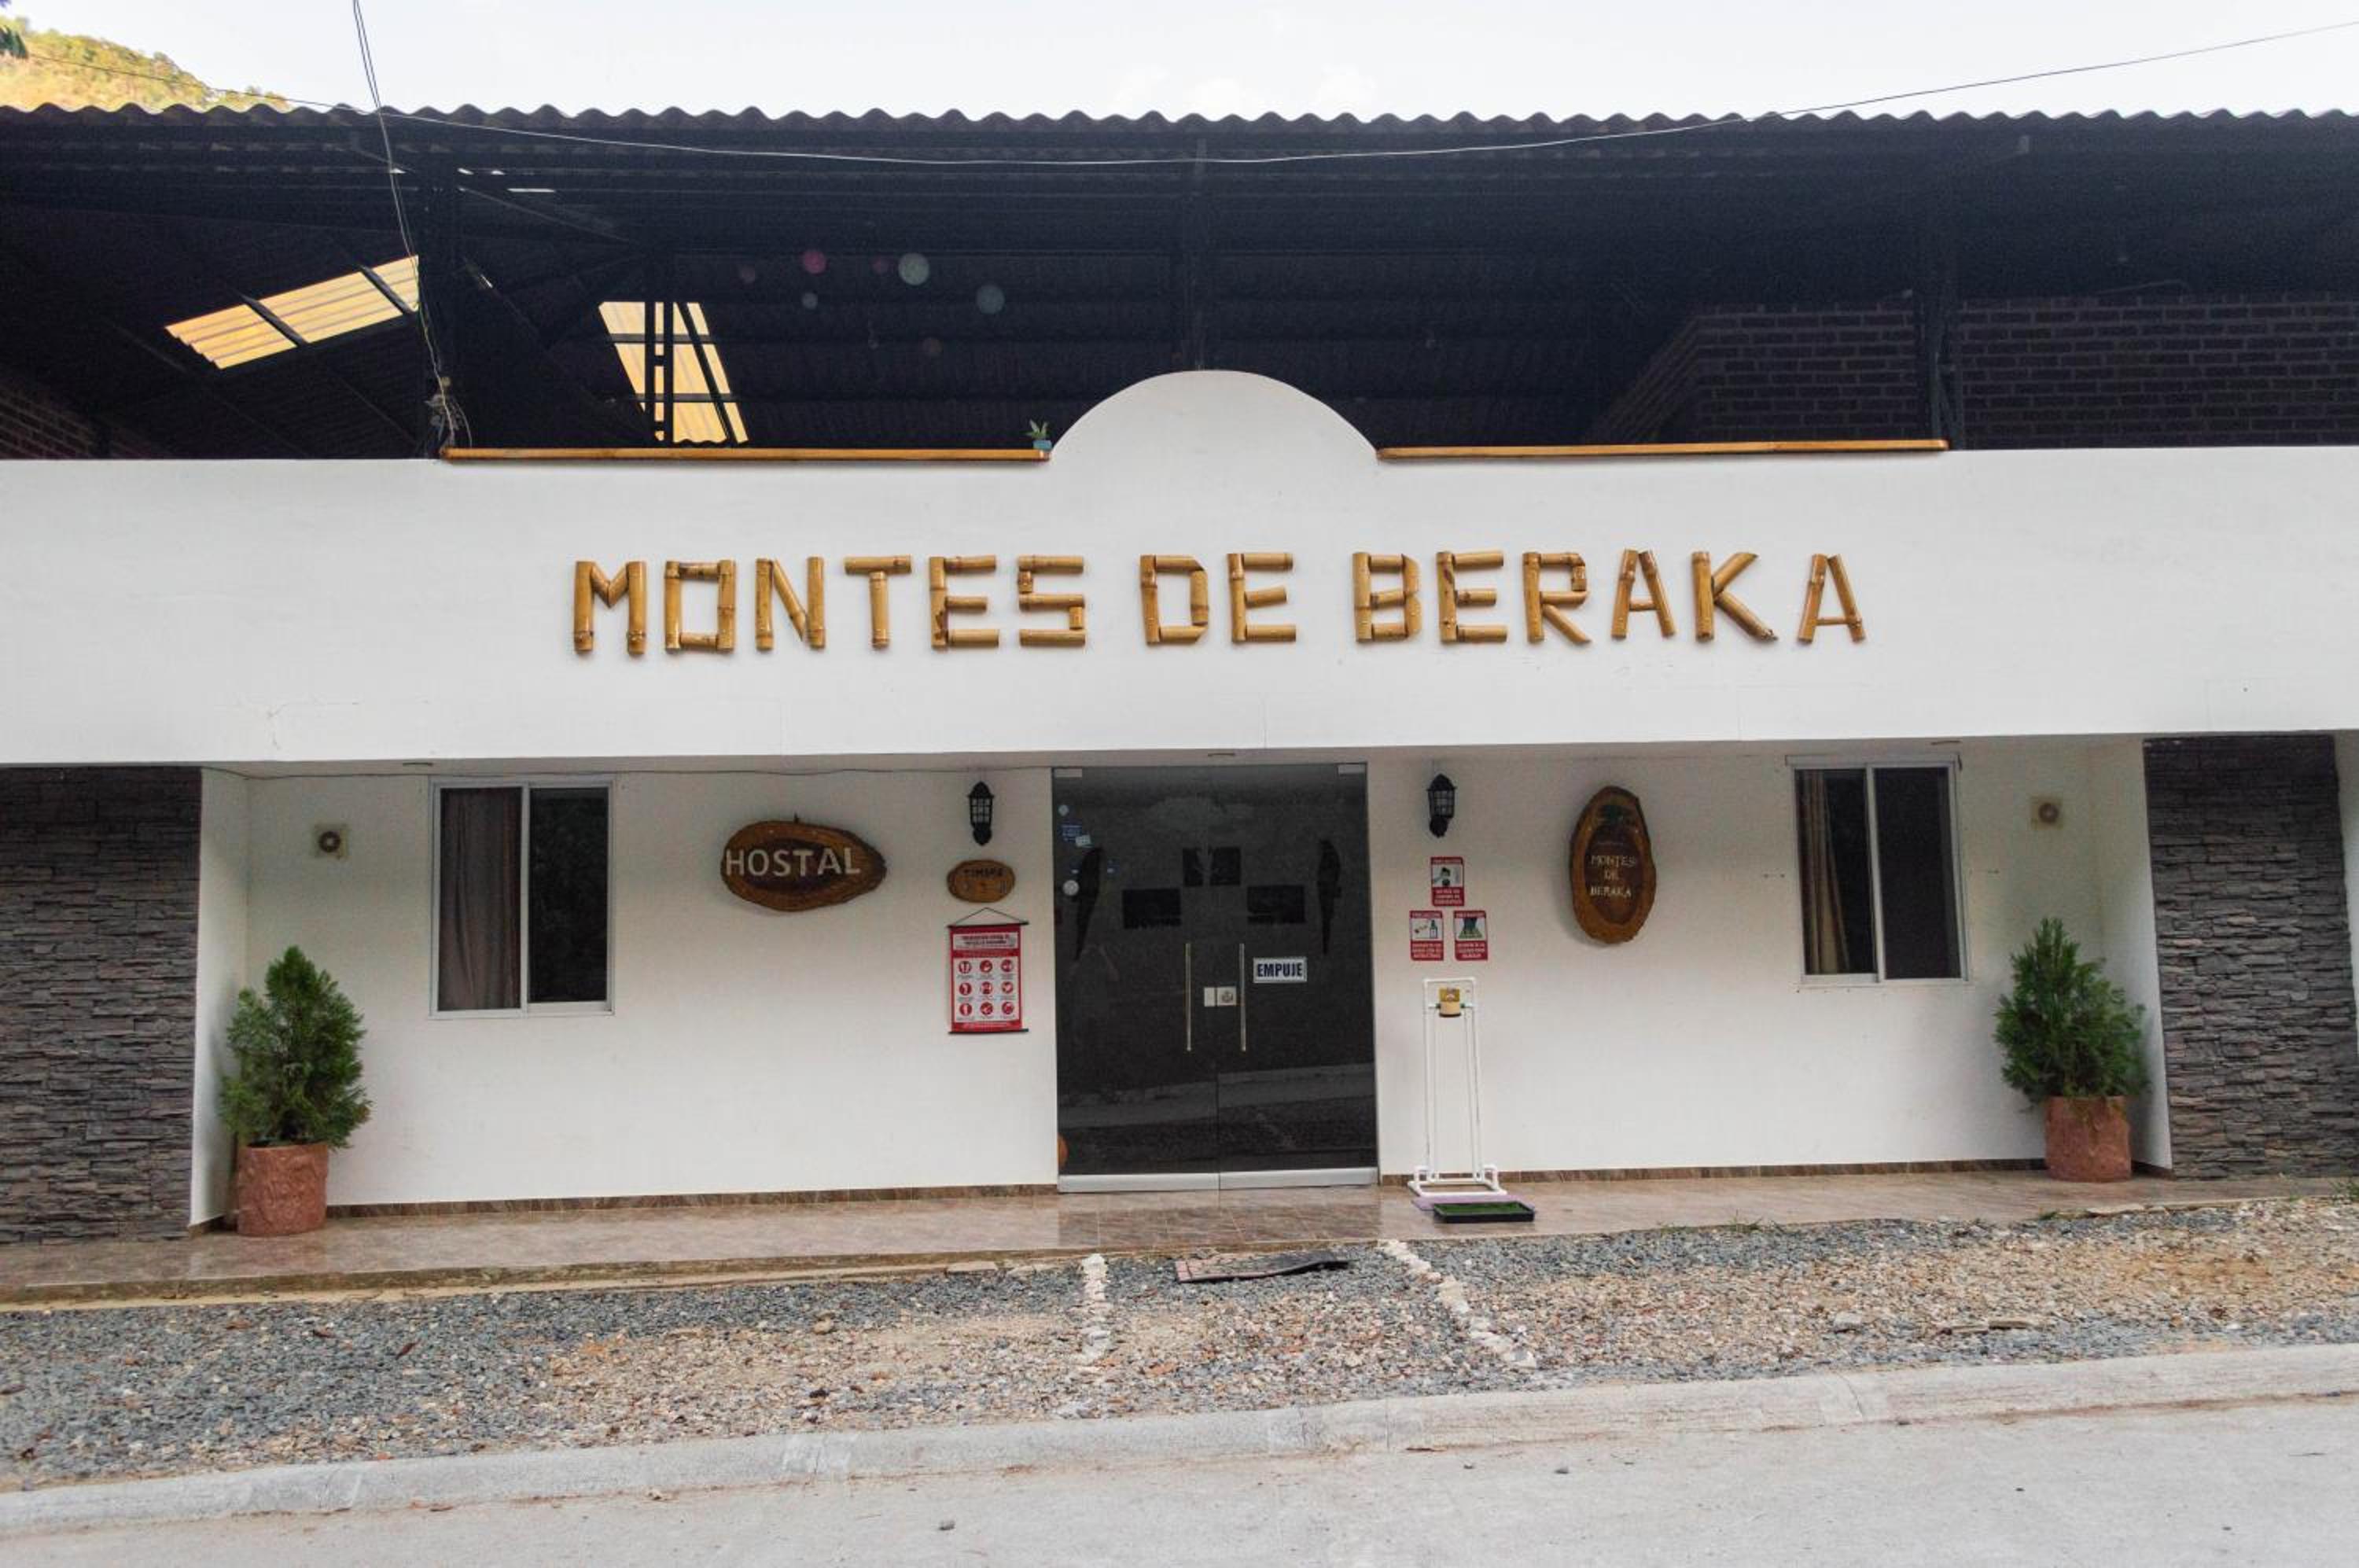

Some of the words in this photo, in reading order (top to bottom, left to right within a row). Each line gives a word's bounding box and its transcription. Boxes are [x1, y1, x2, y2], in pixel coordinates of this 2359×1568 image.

[574, 555, 1086, 654] MONTES
[1139, 553, 1297, 645] DE
[1352, 549, 1866, 644] BERAKA
[725, 847, 861, 877] HOSTAL
[1257, 963, 1303, 977] EMPUJE
